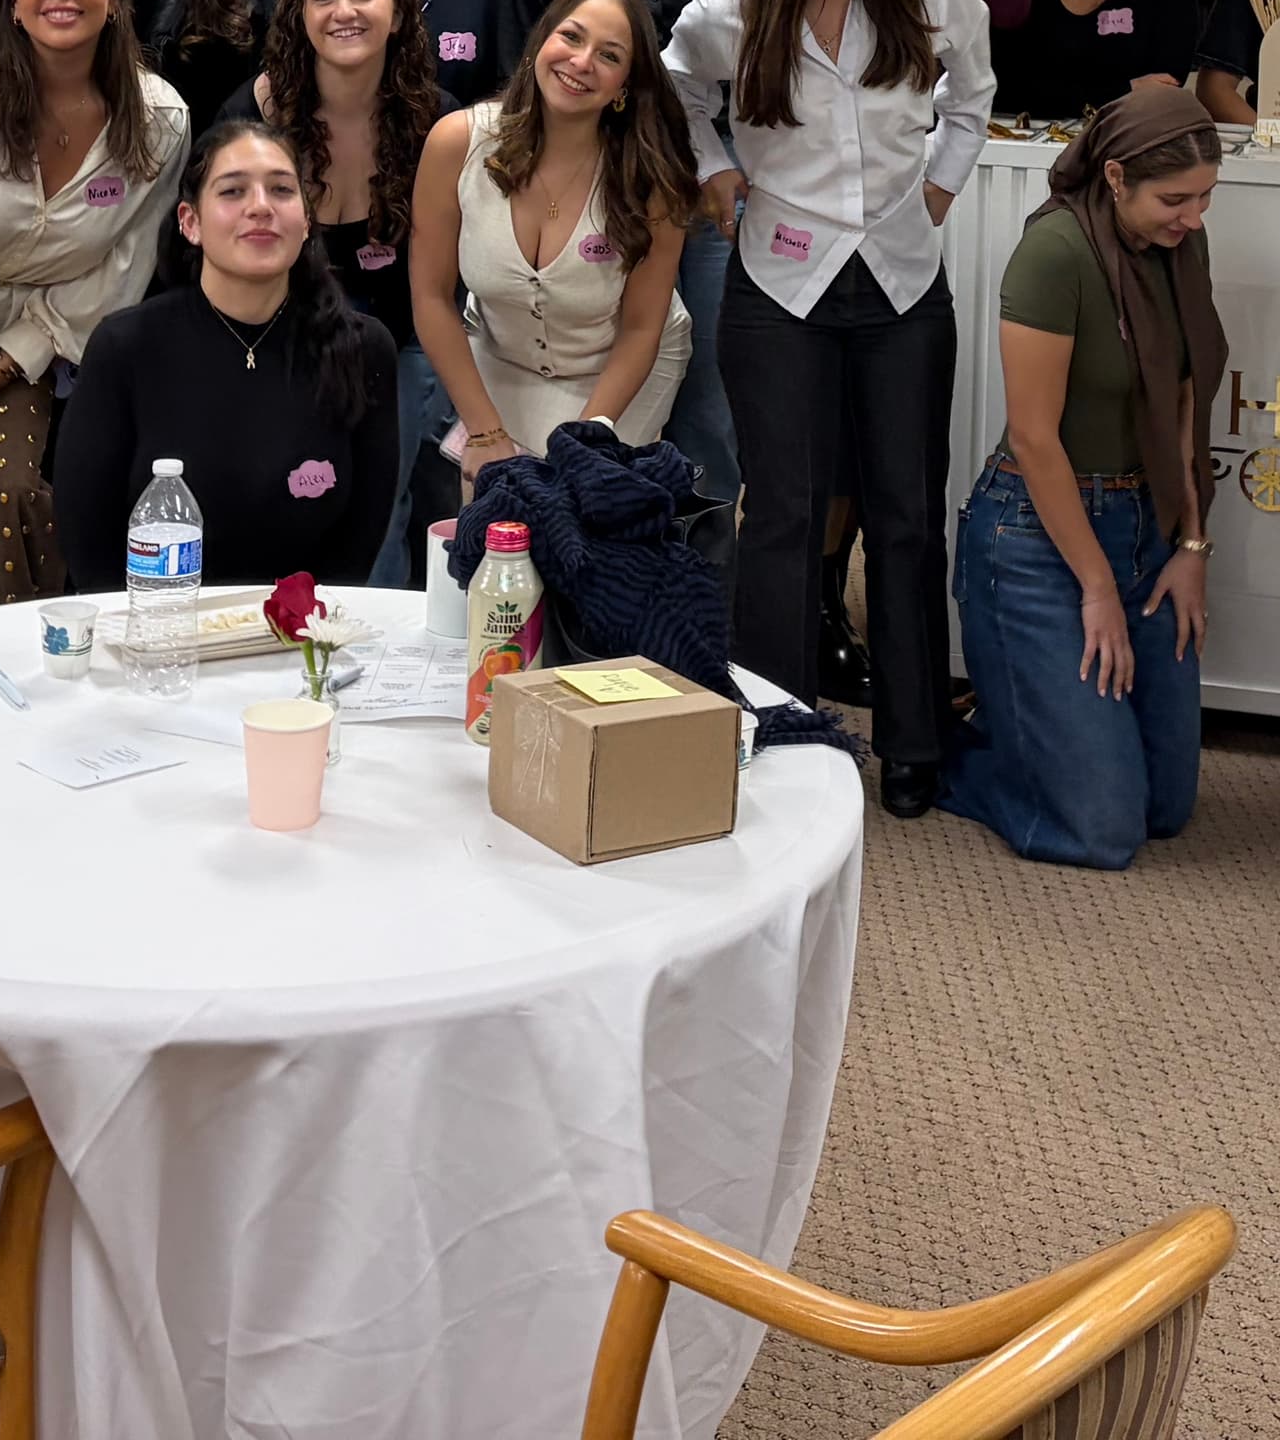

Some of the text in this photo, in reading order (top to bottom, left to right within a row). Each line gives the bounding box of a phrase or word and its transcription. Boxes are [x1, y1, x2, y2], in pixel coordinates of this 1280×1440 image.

[88, 186, 119, 201] Nicole
[487, 611, 522, 624] Saint
[483, 622, 525, 635] James
